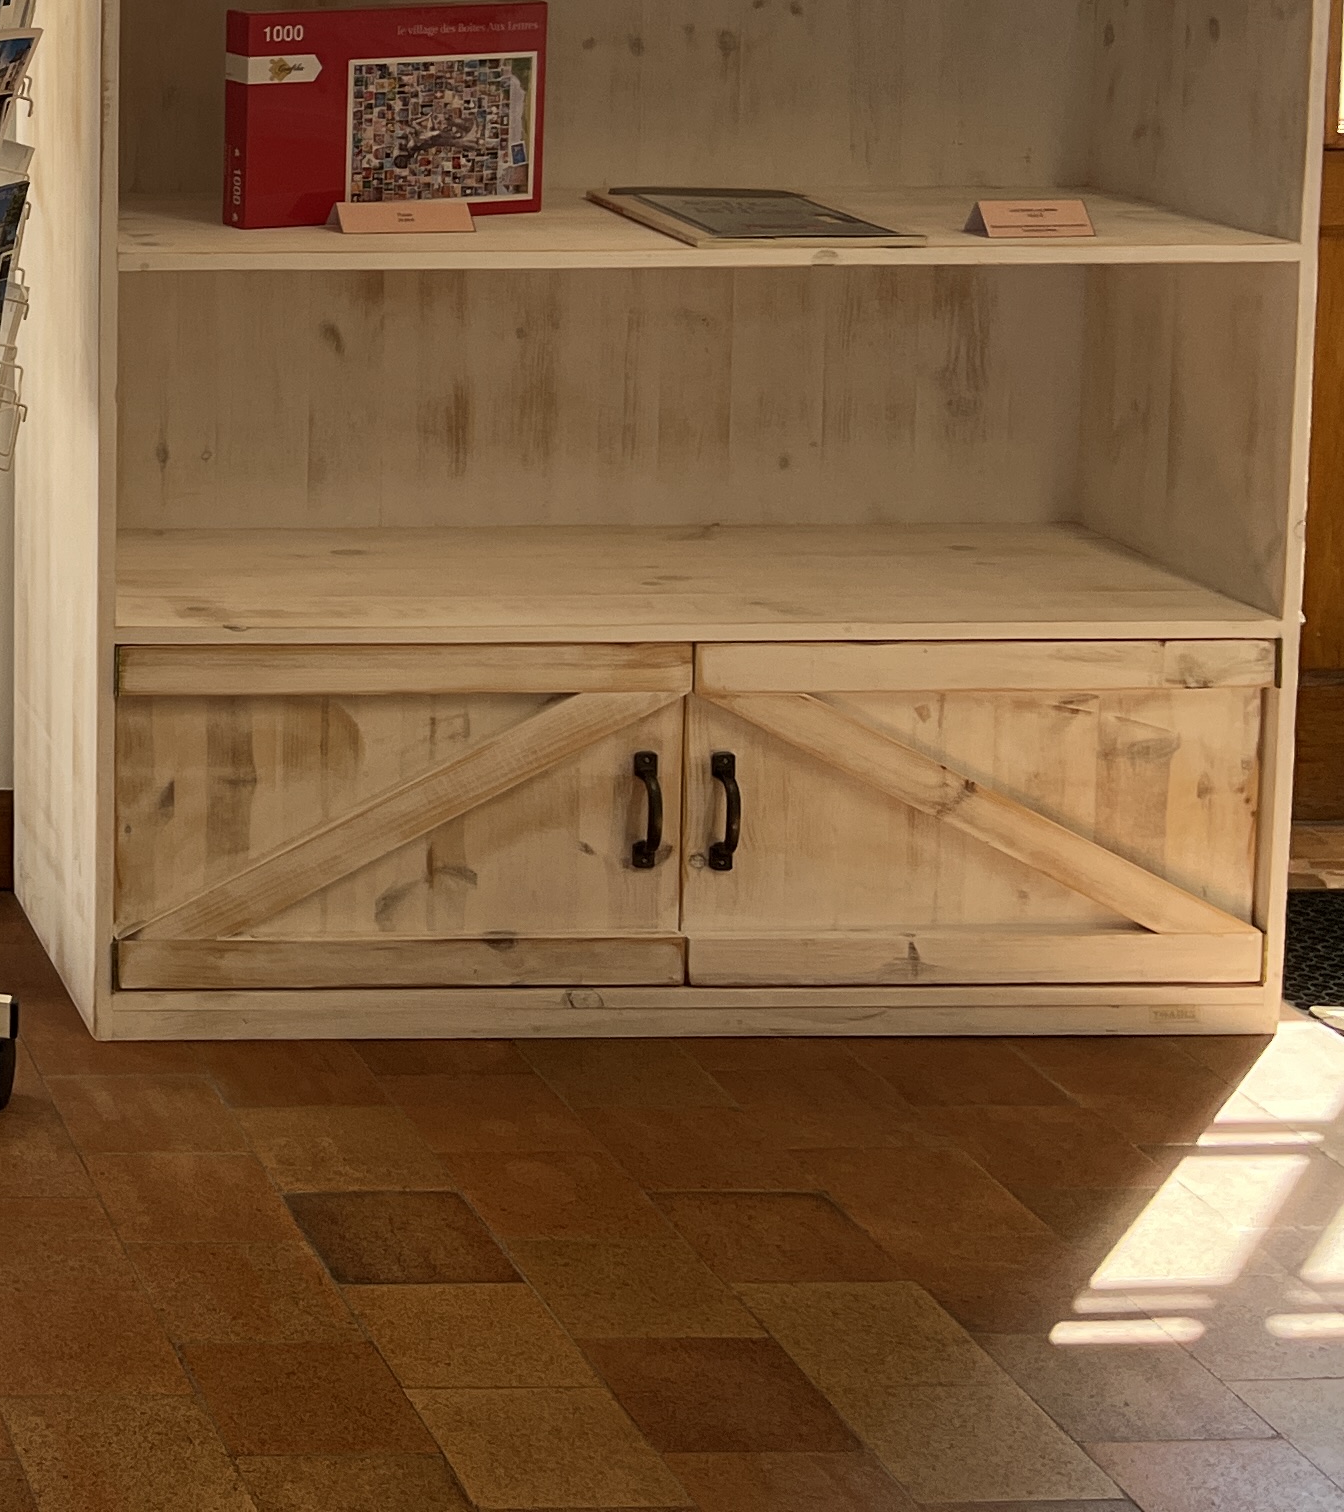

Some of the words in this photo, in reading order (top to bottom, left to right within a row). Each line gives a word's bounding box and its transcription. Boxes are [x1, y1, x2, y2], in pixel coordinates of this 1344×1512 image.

[263, 24, 304, 42] 1000
[408, 24, 439, 37] village
[440, 23, 456, 34] des
[487, 22, 506, 31] Aux
[232, 169, 242, 205] 1000
